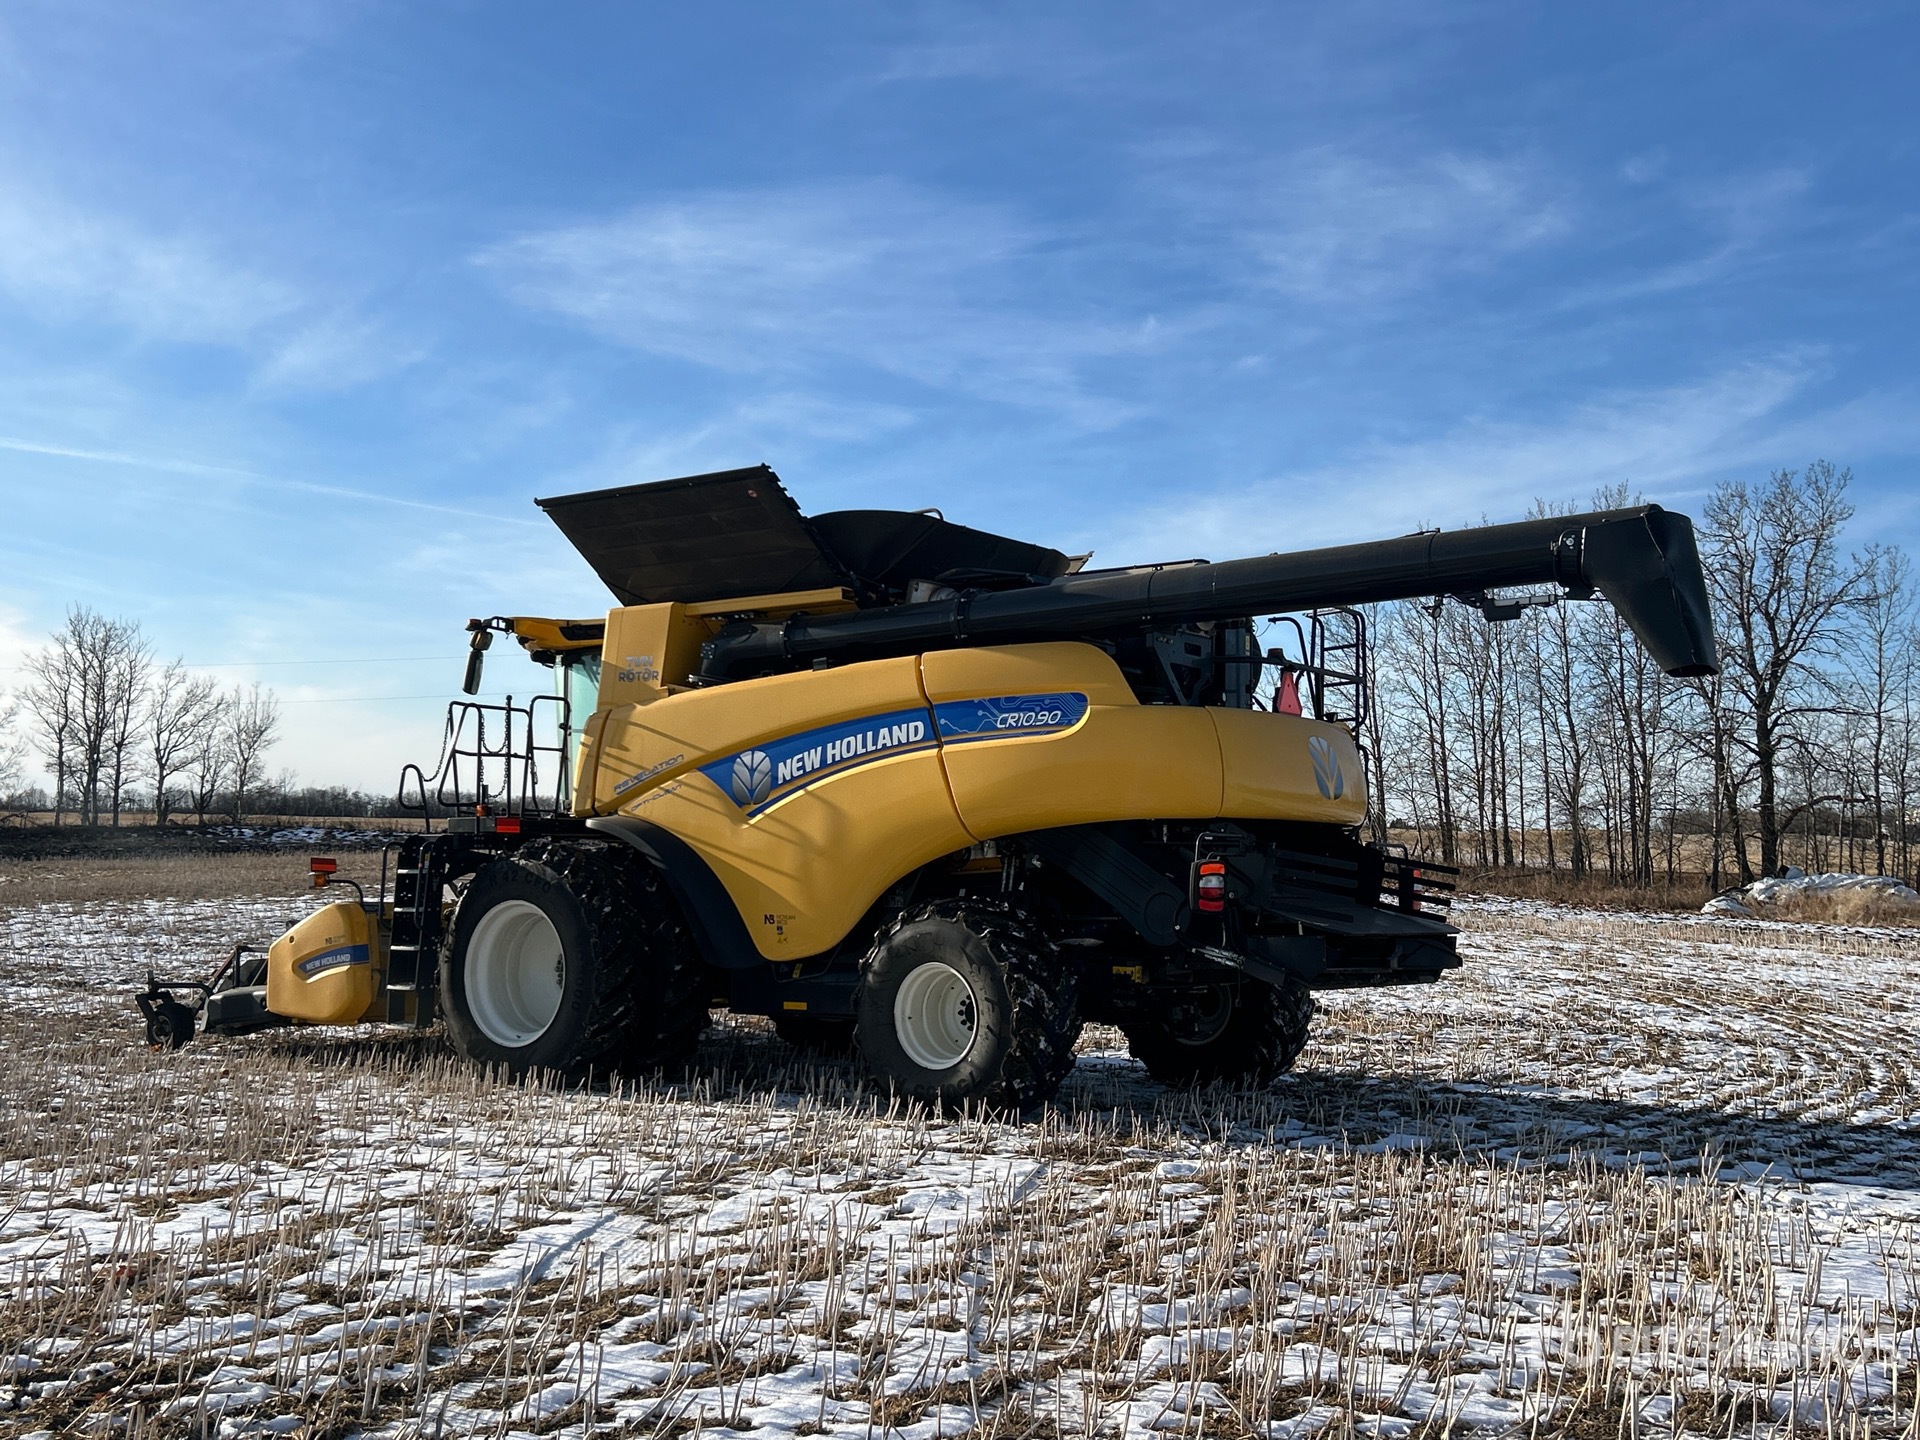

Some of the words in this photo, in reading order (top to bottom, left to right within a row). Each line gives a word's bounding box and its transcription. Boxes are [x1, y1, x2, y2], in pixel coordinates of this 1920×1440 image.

[618, 670, 660, 683] ROTOR
[996, 711, 1062, 729] CR10.90
[777, 746, 823, 785] NEW
[826, 721, 925, 765] HOLLAND
[306, 959, 321, 971] NEW
[321, 953, 351, 967] HOLLAND
